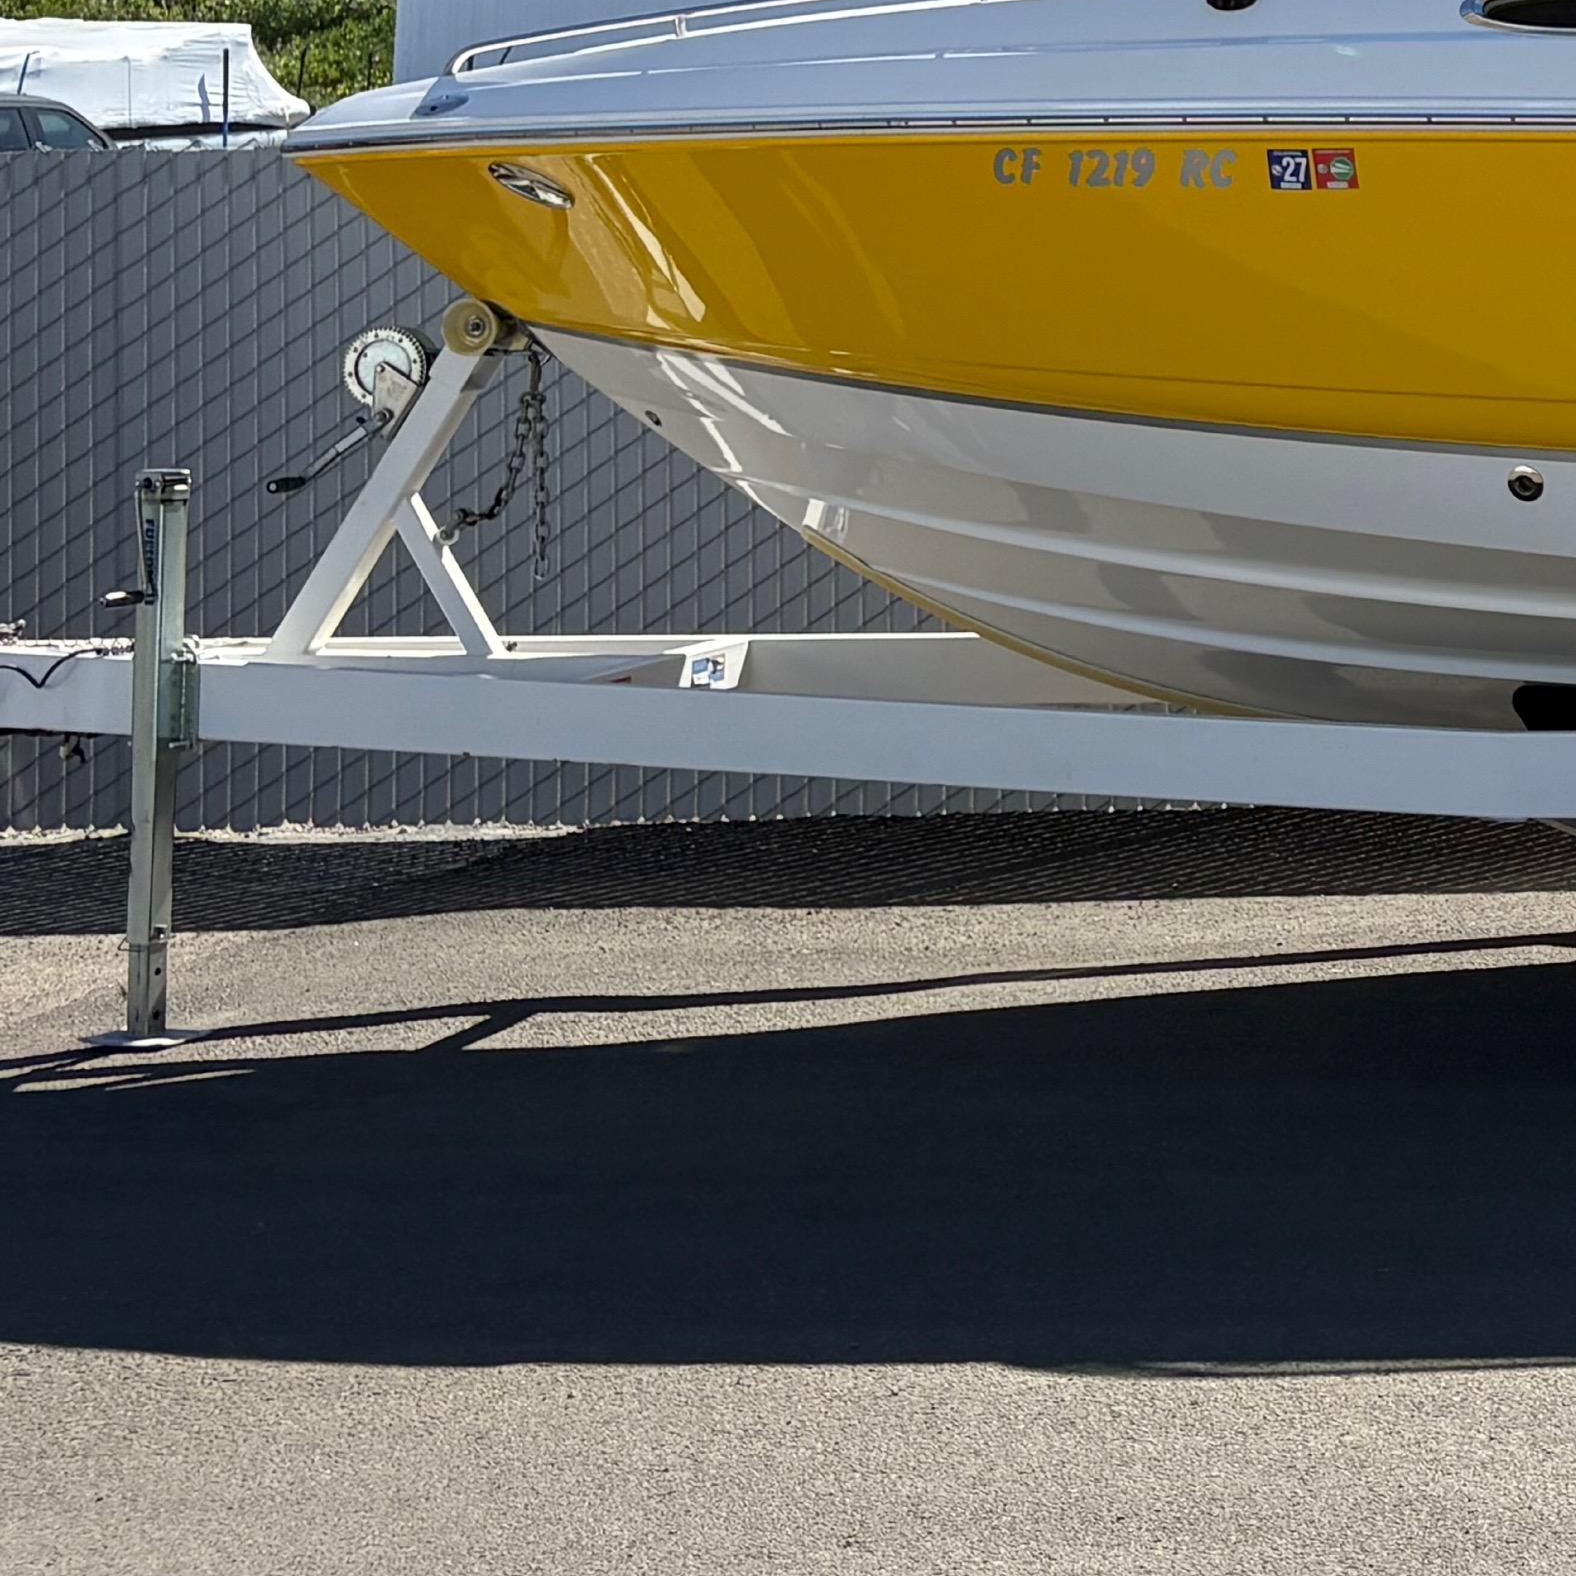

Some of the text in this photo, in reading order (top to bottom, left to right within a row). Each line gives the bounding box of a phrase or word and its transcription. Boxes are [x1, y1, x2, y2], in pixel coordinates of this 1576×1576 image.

[992, 147, 1237, 189] CF 1219 RC
[1281, 156, 1307, 183] 27
